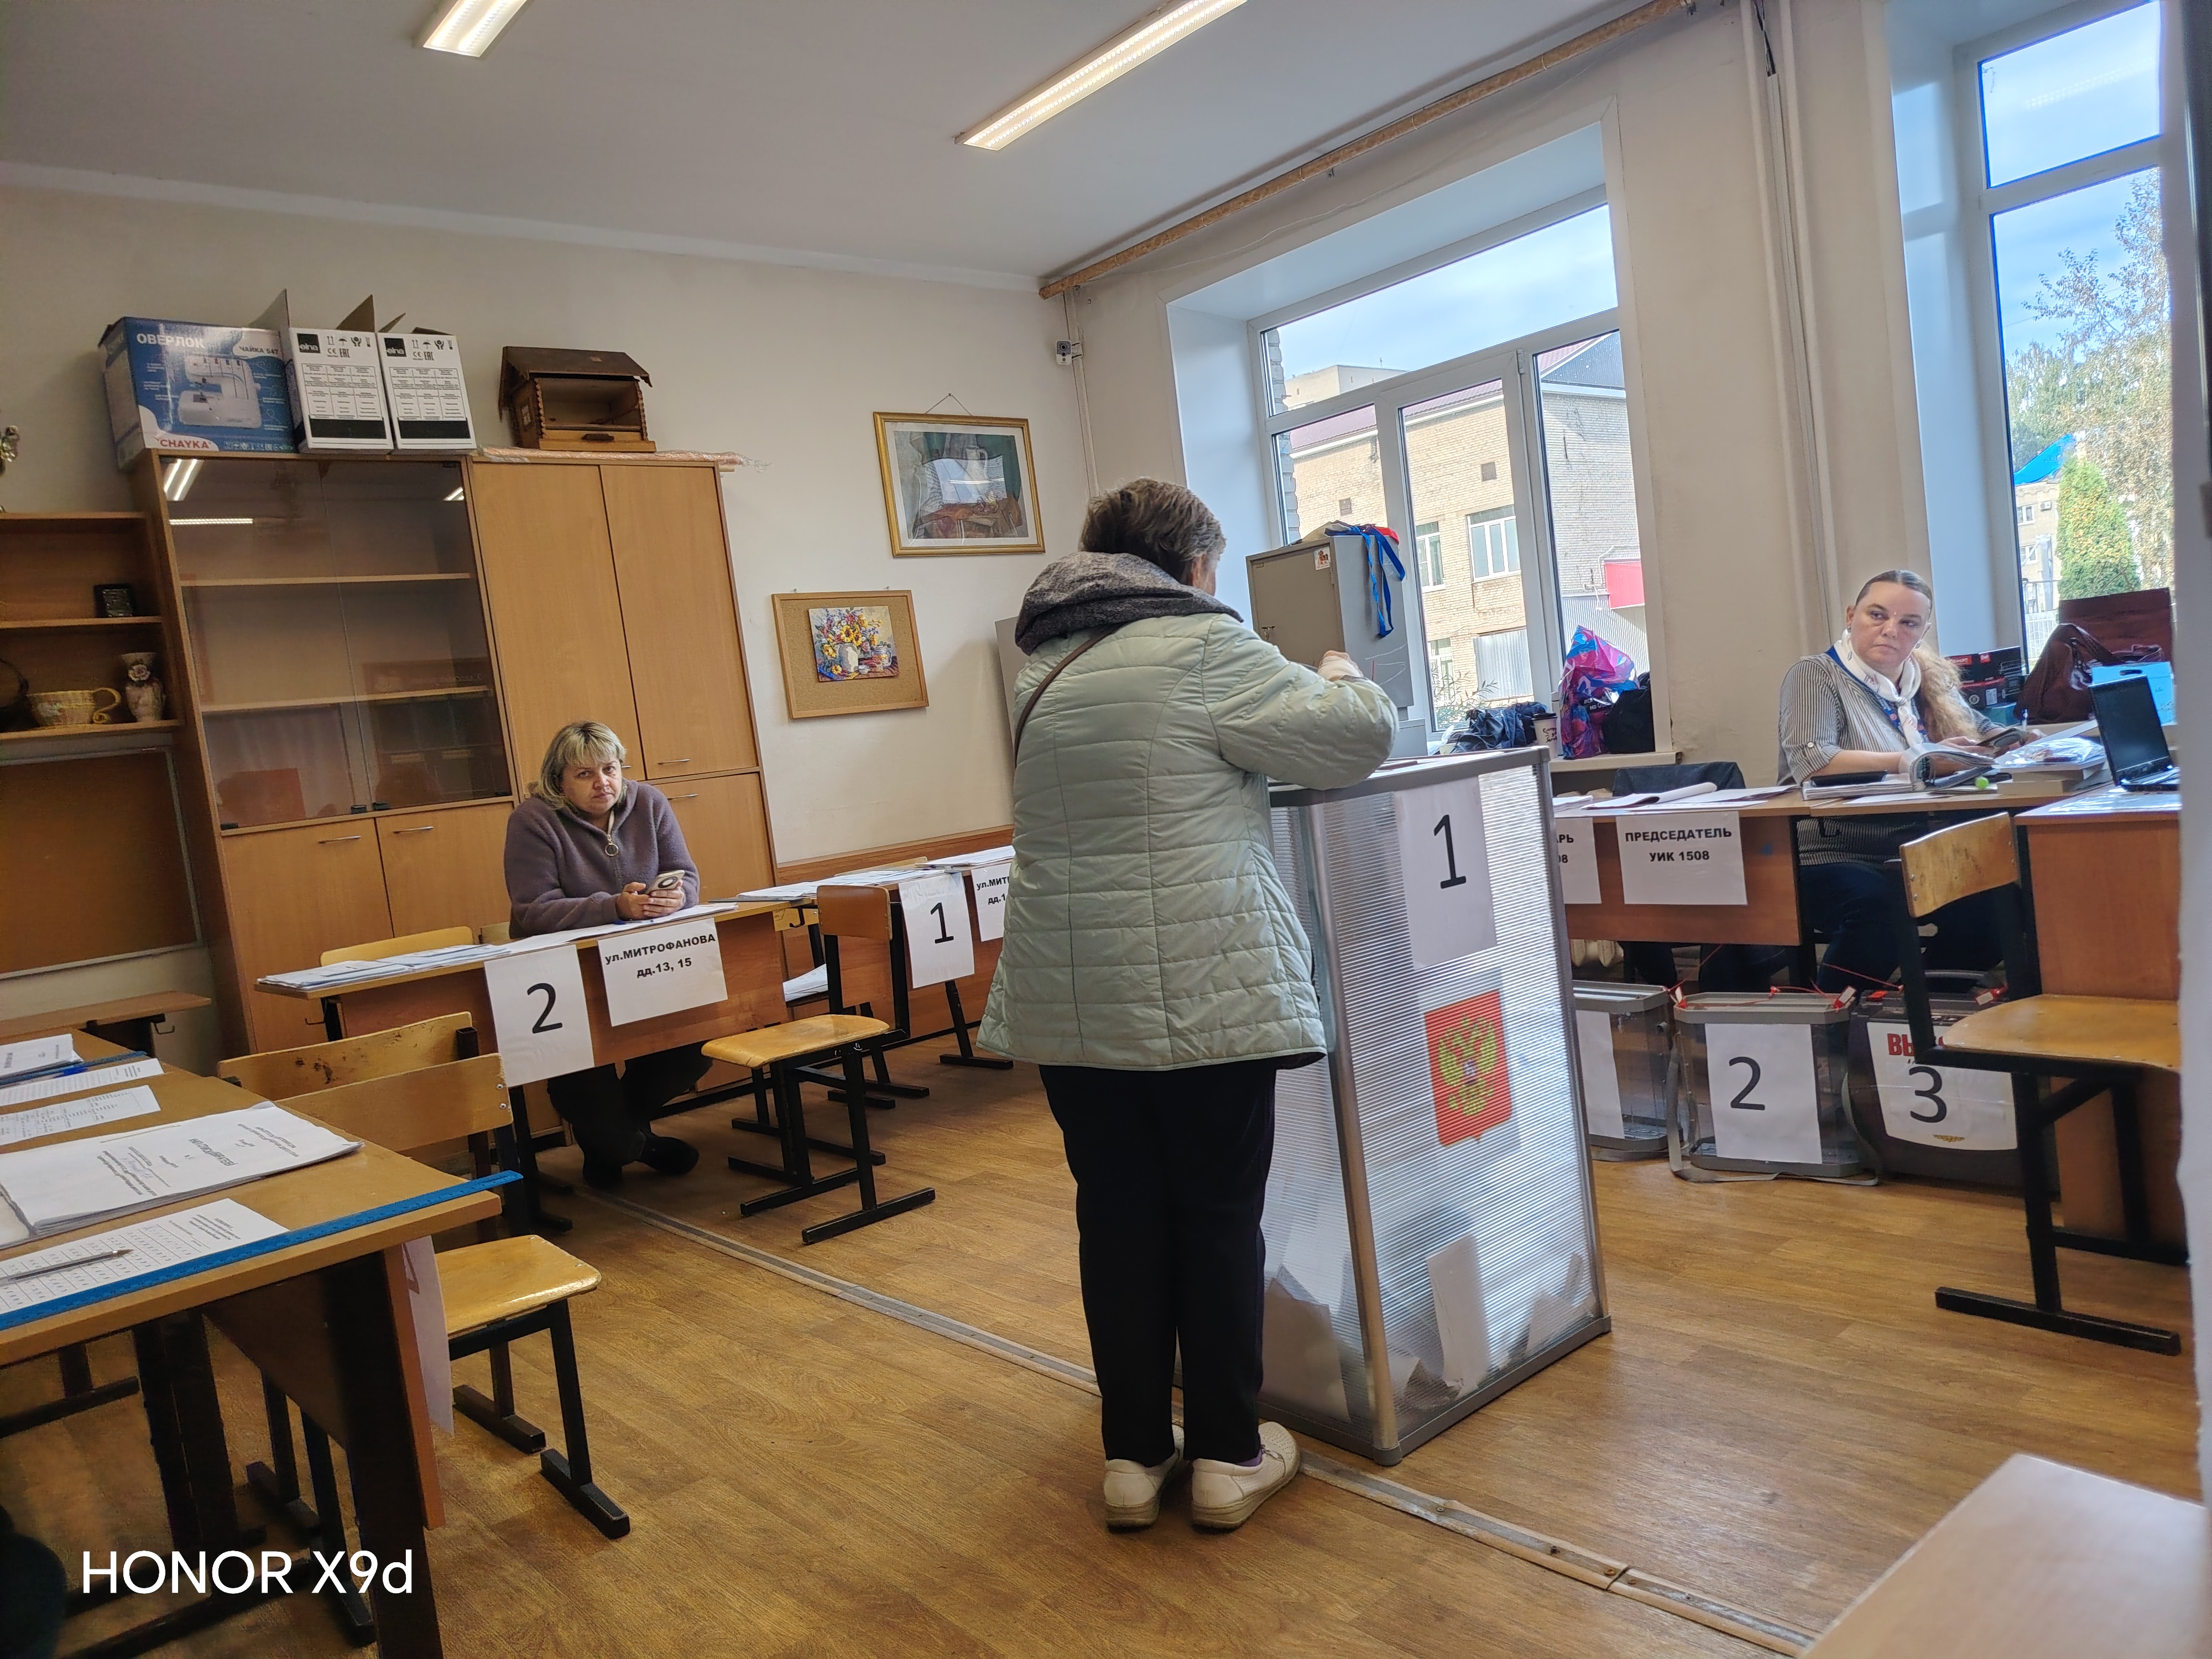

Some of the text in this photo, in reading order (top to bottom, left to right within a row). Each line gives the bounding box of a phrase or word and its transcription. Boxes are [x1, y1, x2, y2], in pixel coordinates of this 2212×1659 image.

[137, 333, 205, 348] ОВЕРЛОК
[299, 342, 319, 351] elna
[239, 346, 264, 354] ЧАЙКА
[387, 346, 405, 354] elna
[160, 439, 210, 449] CHAYKA
[1625, 827, 1732, 842] ПРЕДСЕДАТЕЛЬ
[1433, 814, 1467, 889] 1
[1649, 850, 1710, 862] УИК 1508
[930, 902, 954, 944] 1
[604, 933, 716, 965] ул.МИТРОФАНОВА
[637, 958, 692, 979] дд.13, 15
[527, 983, 563, 1034] 2
[1729, 1056, 1766, 1111] 2
[1908, 1066, 1947, 1123] 3
